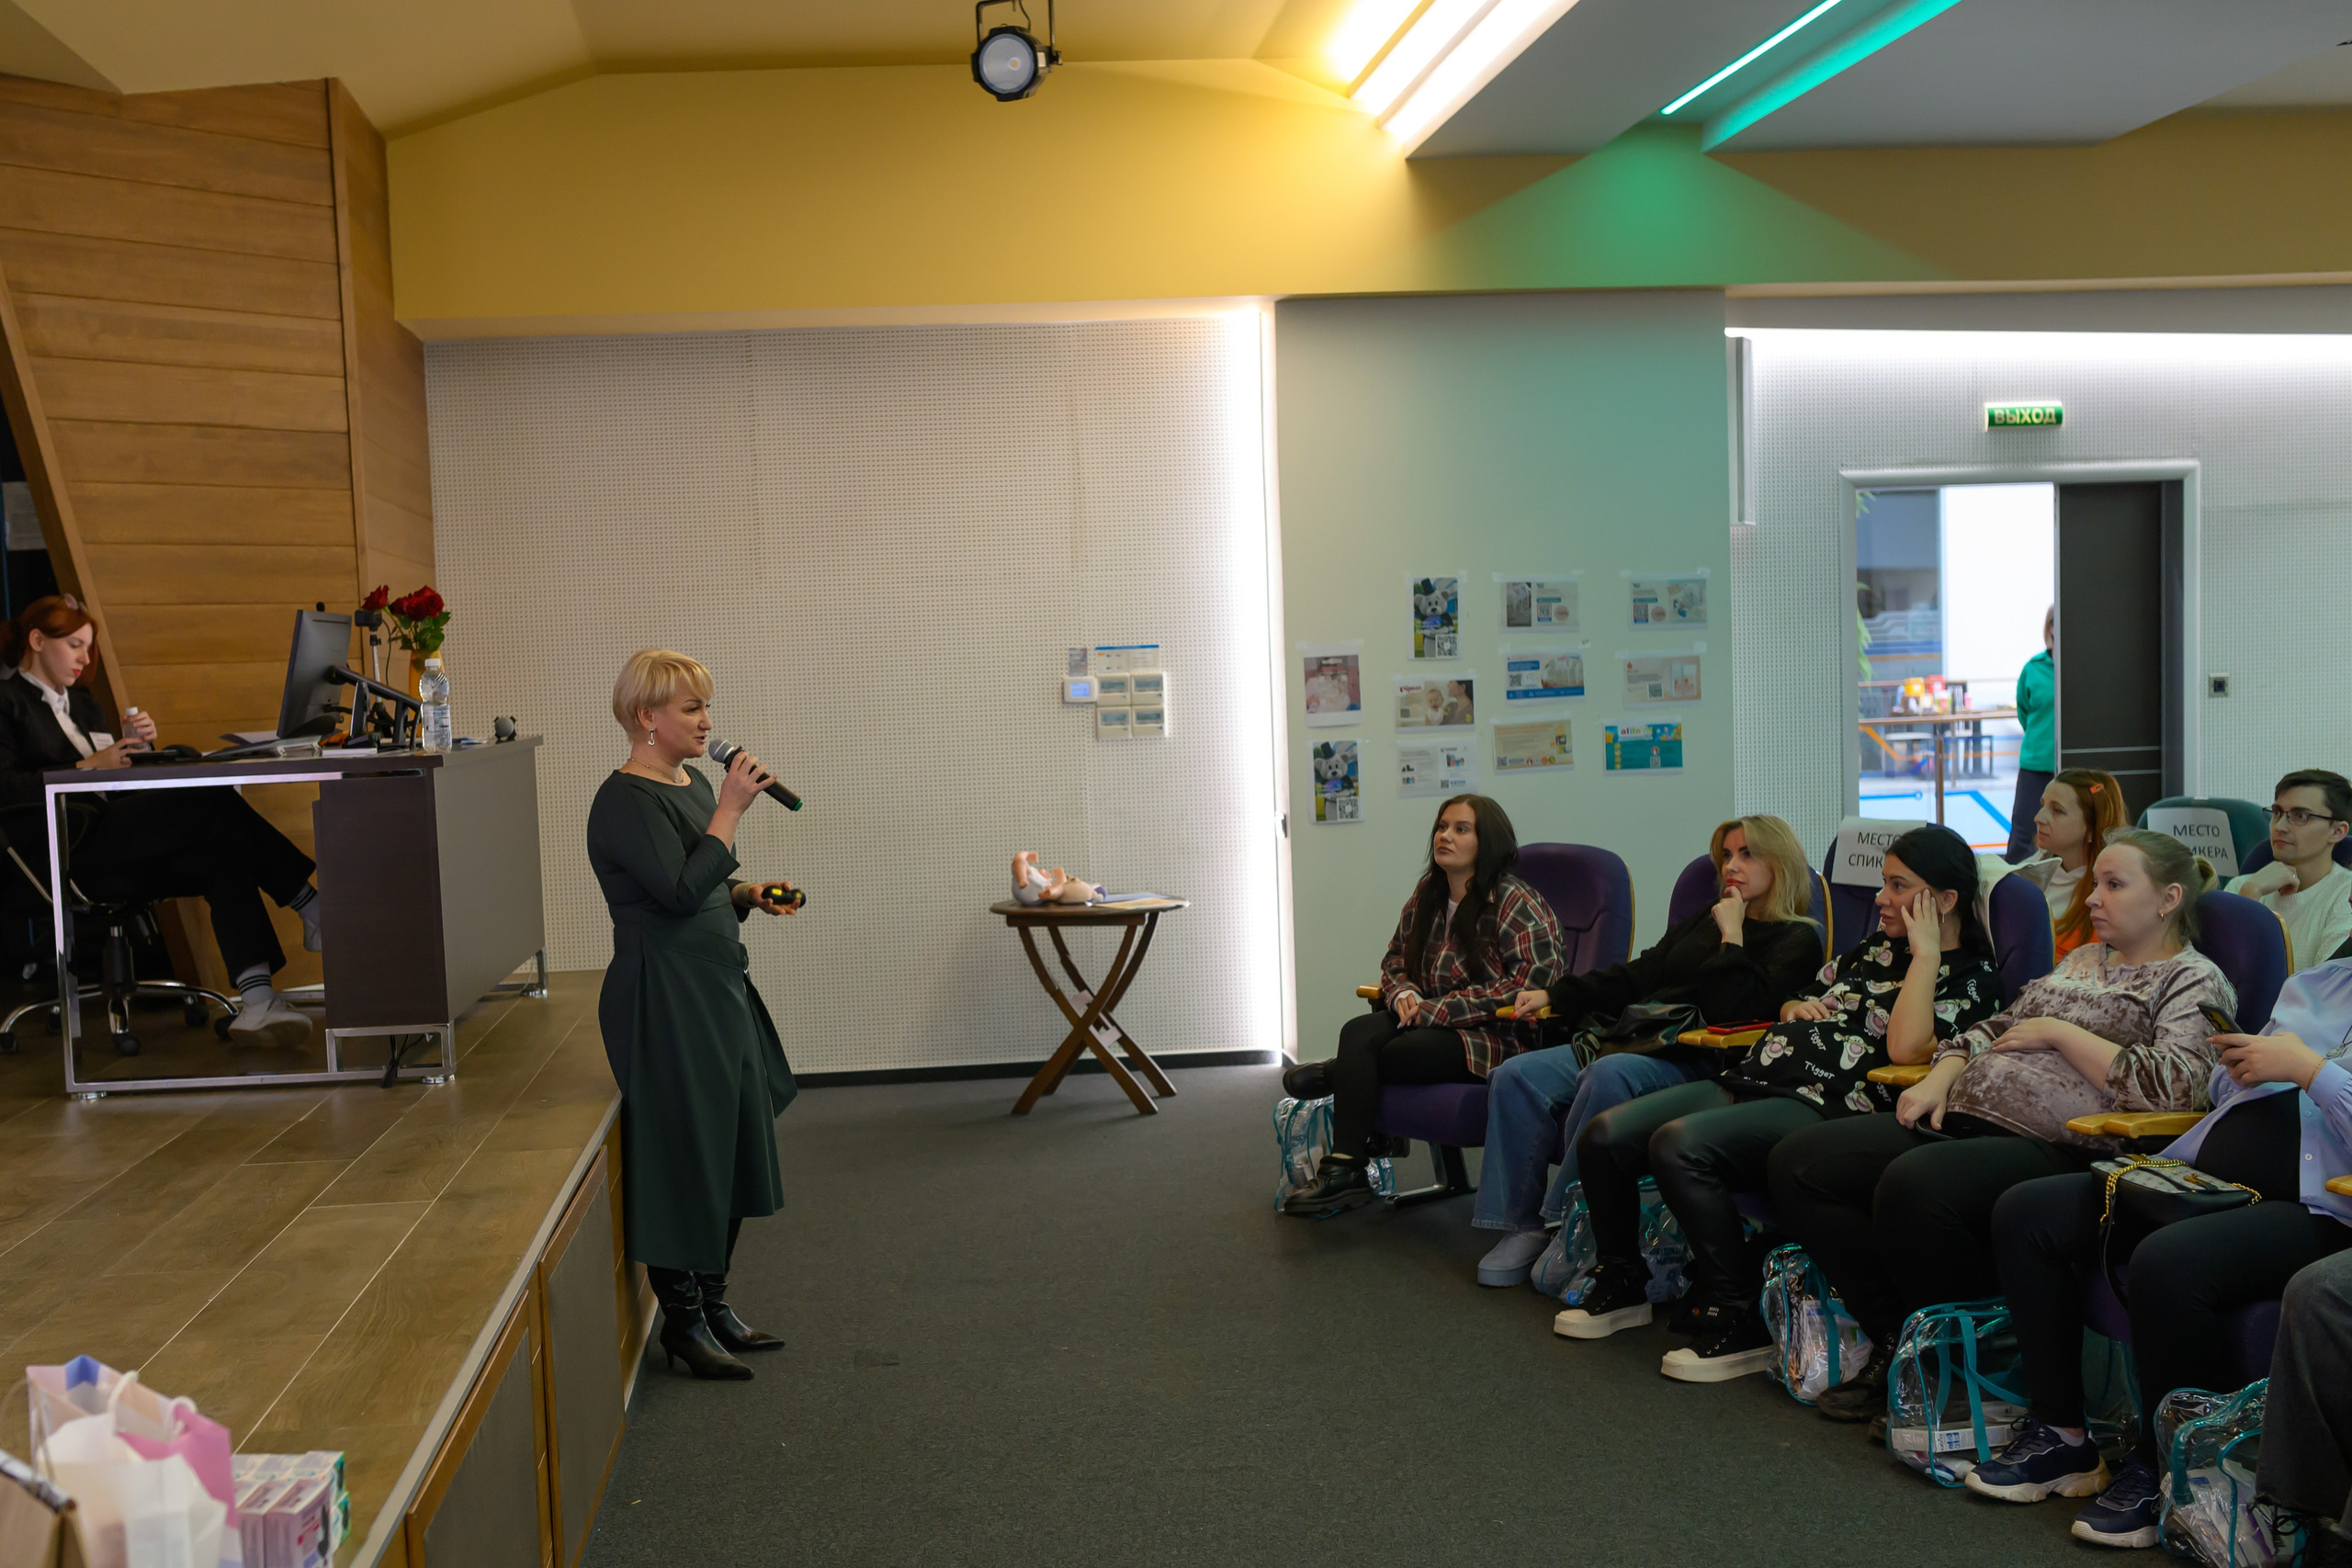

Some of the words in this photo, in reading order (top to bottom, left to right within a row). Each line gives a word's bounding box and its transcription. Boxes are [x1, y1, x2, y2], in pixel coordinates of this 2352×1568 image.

[1994, 408, 2057, 424] ВЫХОД
[2173, 823, 2221, 838] МЕСТО
[1848, 853, 1883, 869] СПИК
[1808, 1026, 1826, 1052] Tigger
[1804, 1060, 1836, 1079] Tigger
